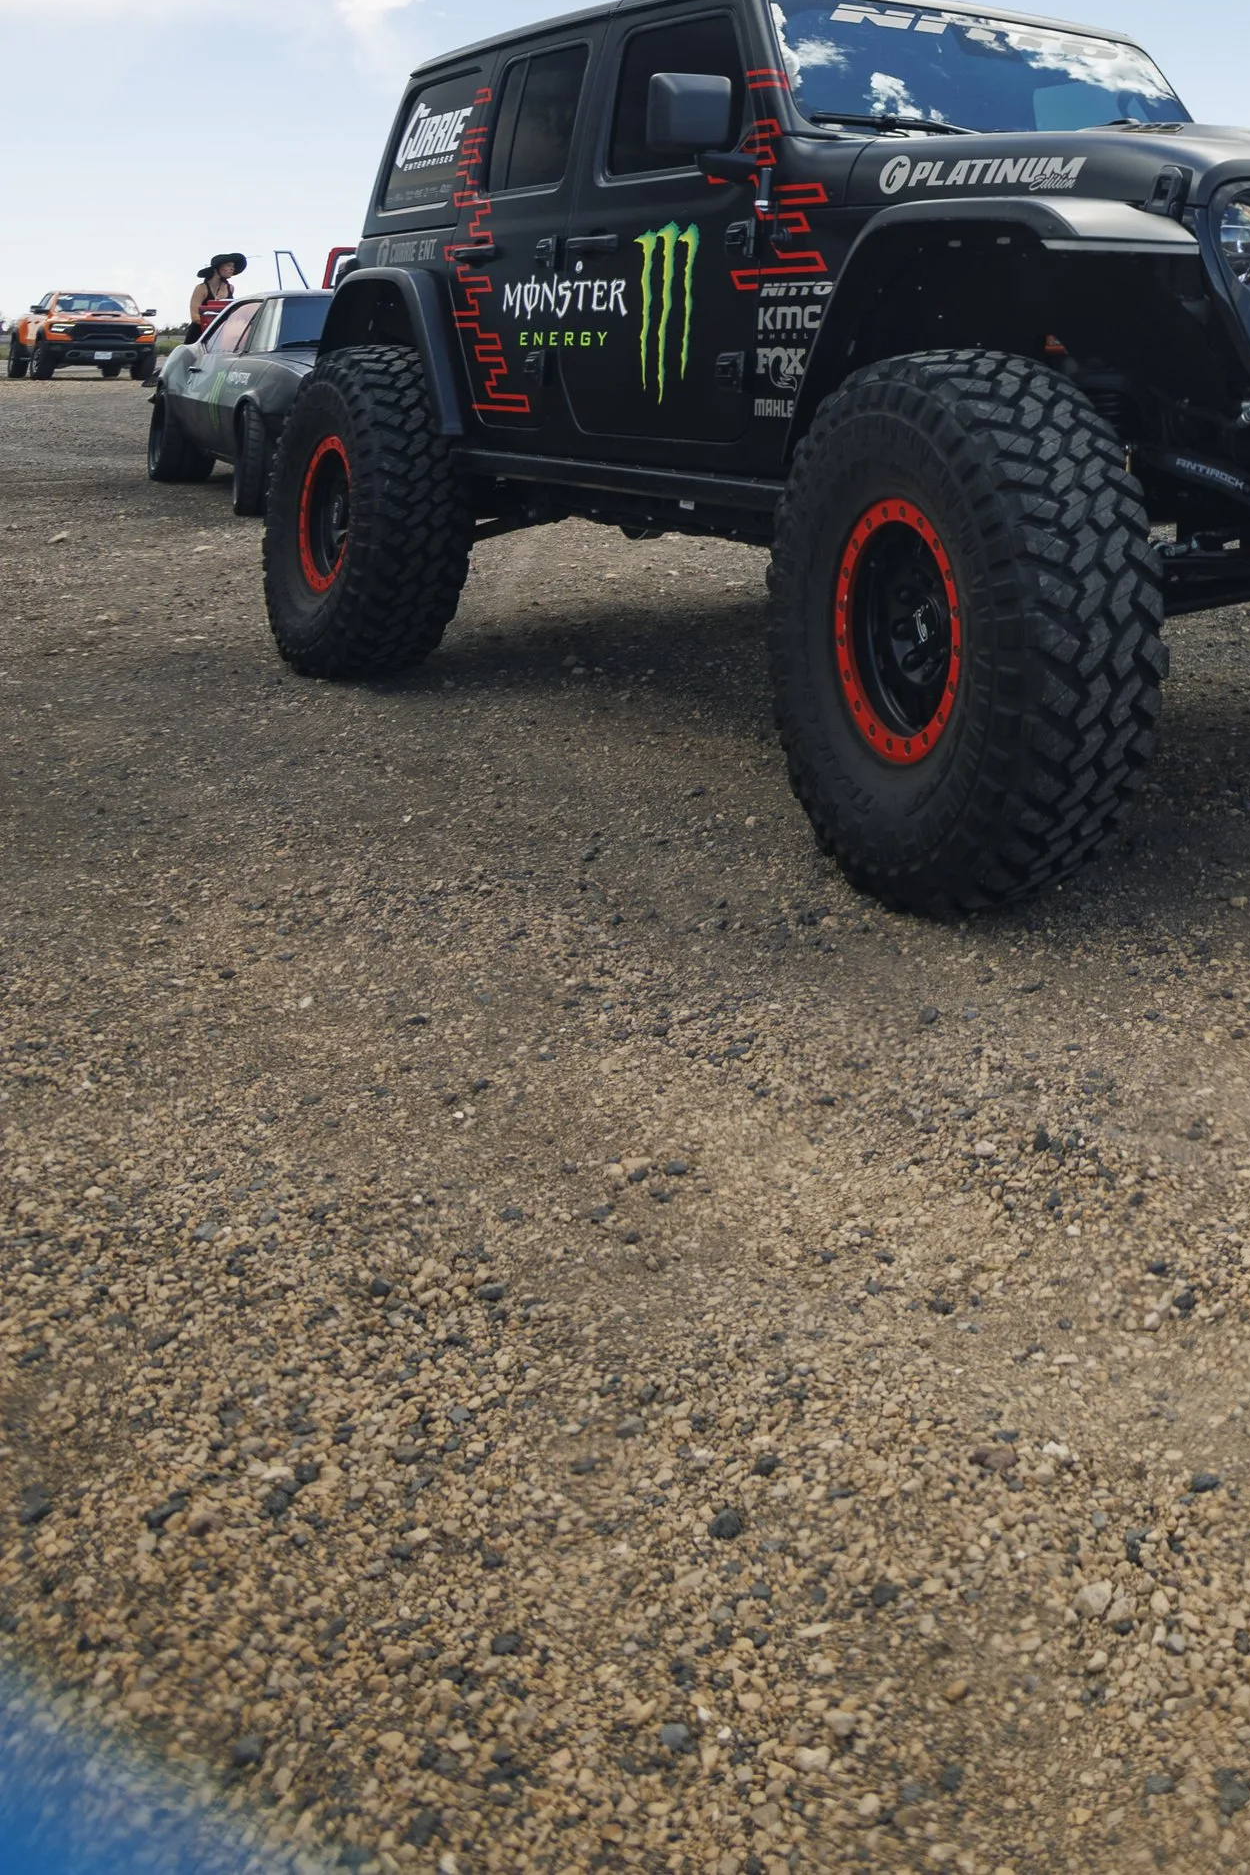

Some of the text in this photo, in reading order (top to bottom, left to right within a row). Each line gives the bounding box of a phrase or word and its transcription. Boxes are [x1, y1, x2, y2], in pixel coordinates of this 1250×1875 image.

[830, 3, 1118, 60] NITTO
[395, 102, 474, 168] CURRIE
[403, 154, 454, 172] ENTERPRISES
[908, 157, 1088, 187] PLATINUM
[1029, 171, 1077, 191] Edition
[389, 241, 418, 263] CURRIE
[503, 273, 628, 320] MONSTER
[760, 281, 834, 296] NITTO
[758, 305, 822, 330] KMC
[520, 331, 608, 346] ENERGY
[756, 346, 806, 385] FOX
[754, 398, 794, 417] MAHLE
[1175, 457, 1245, 489] ANTIROCK
